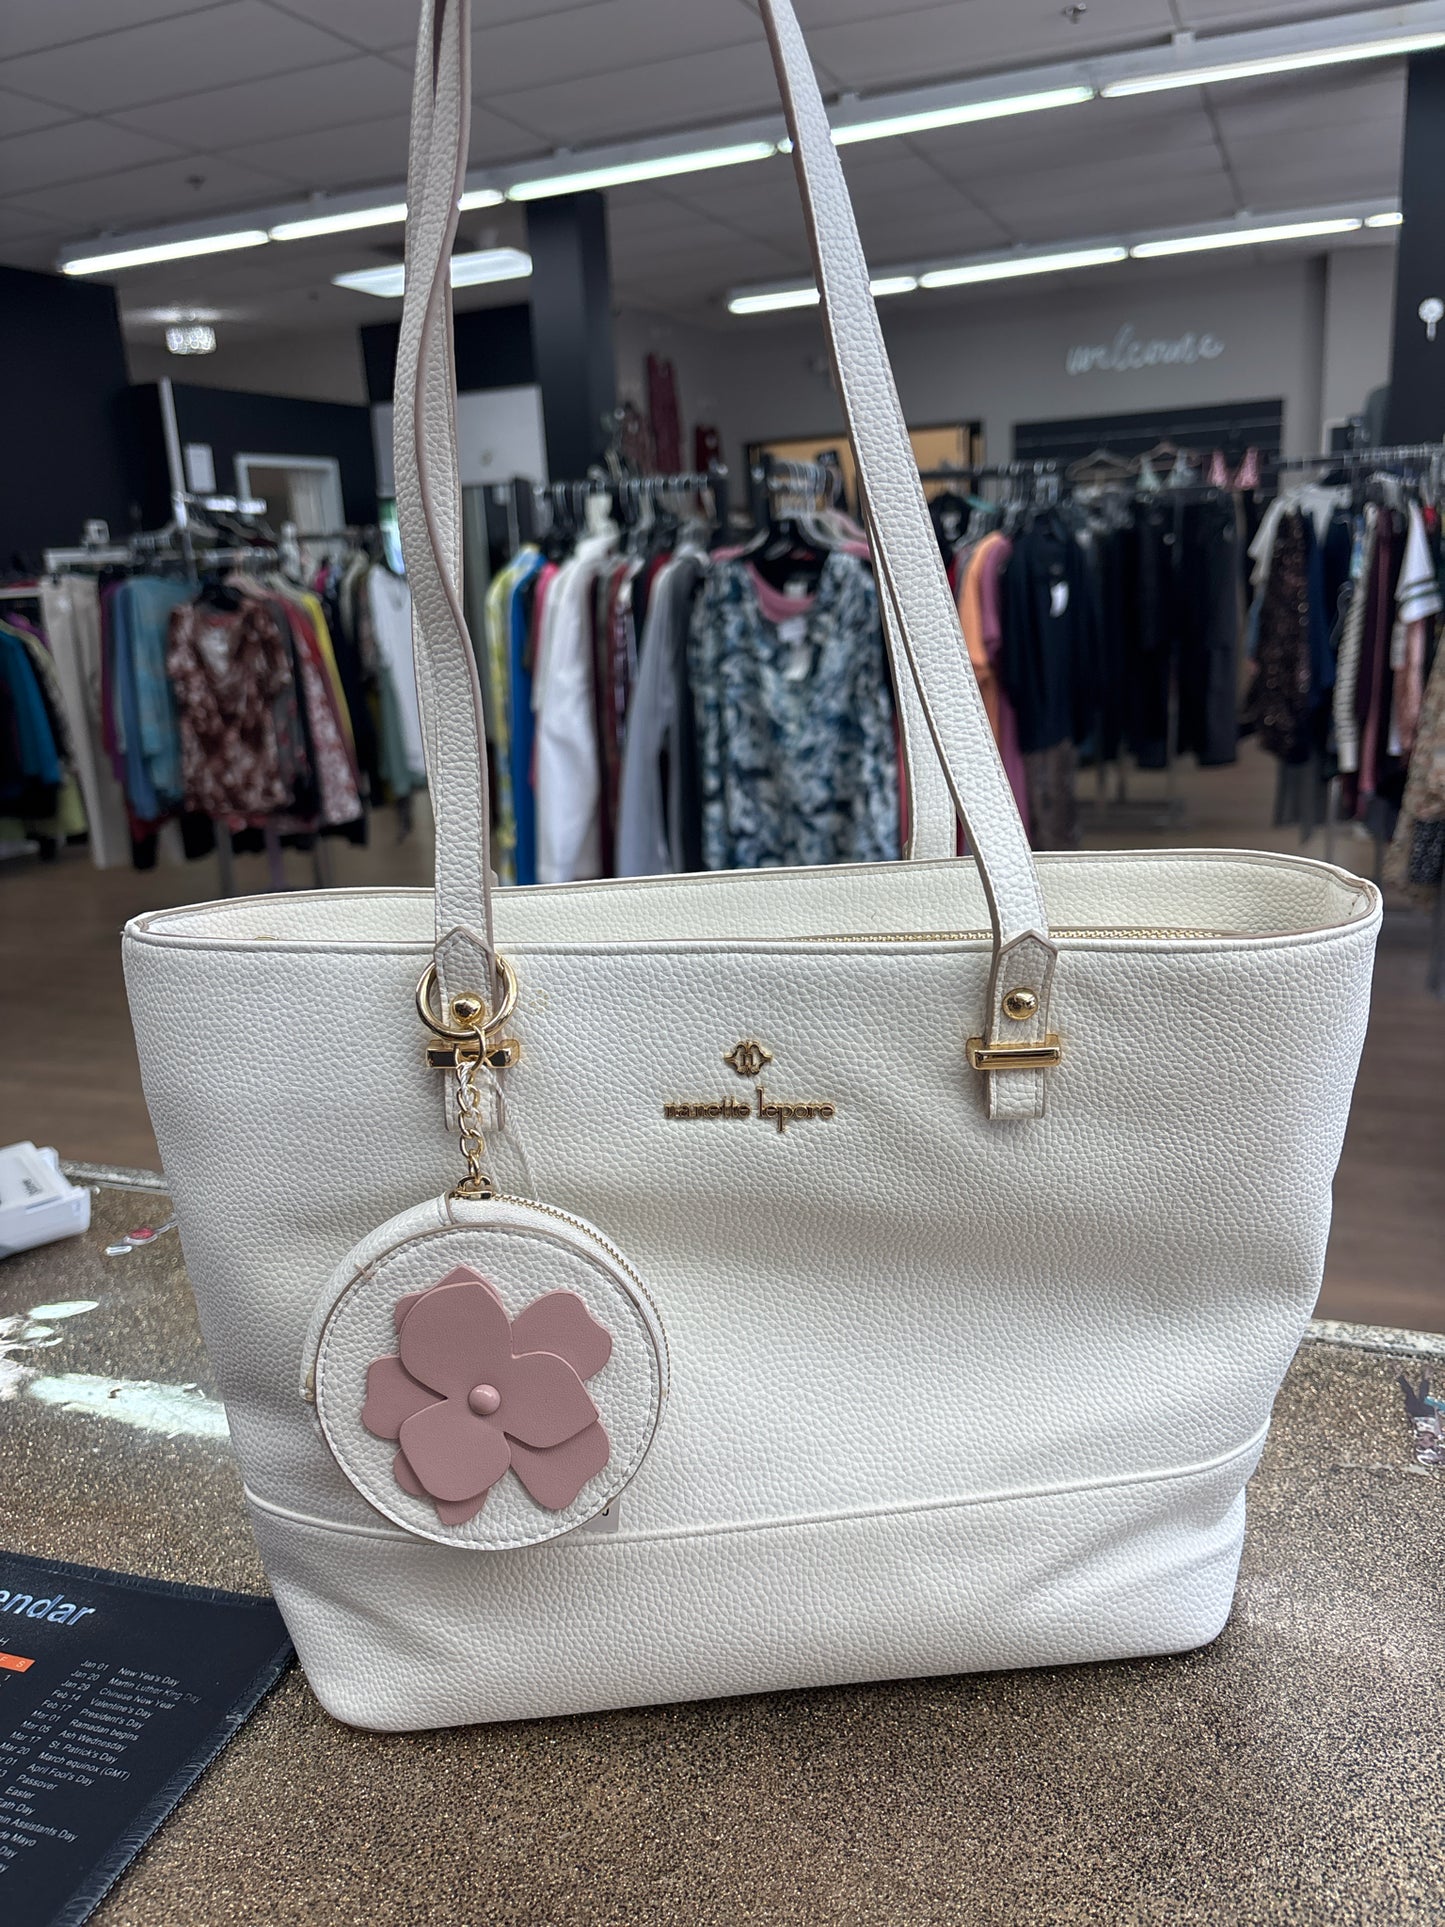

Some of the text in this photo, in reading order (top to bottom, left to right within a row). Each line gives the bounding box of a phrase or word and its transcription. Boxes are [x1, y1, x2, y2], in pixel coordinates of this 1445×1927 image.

[664, 1085, 836, 1134] nanette lepore
[81, 1660, 109, 1671] Jan 01
[70, 1670, 100, 1681] Jan 20
[118, 1667, 138, 1677] New
[161, 1676, 180, 1687] Day
[61, 1680, 91, 1691] Jan 29
[108, 1677, 135, 1689] Martin
[135, 1683, 163, 1695] Luther
[163, 1688, 183, 1700] King
[51, 1689, 82, 1702] Feb 14
[99, 1687, 176, 1710] Chinese New Year
[41, 1699, 73, 1712] Feb 17
[90, 1697, 154, 1719] Valentine's Day
[30, 1710, 61, 1722] Mar 01
[79, 1708, 145, 1730] President's Day
[20, 1720, 52, 1733] Mar 05
[69, 1719, 140, 1741] Ramadan begins
[10, 1731, 42, 1744] Mar 17
[58, 1729, 128, 1753] Ash Wednesday
[0, 1742, 31, 1755] Mar 20
[62, 1743, 99, 1759] Patrick's
[99, 1752, 118, 1764] Day
[5, 1757, 18, 1766] 01
[38, 1751, 131, 1781] March equinox (GMT)
[16, 1774, 58, 1790] Passover
[26, 1763, 95, 1787] April Fool's Day
[5, 1785, 36, 1799] Easter
[15, 1803, 36, 1816] Day
[10, 1818, 58, 1836] Assistants
[57, 1829, 79, 1843] Day
[10, 1833, 37, 1847] Mayo
